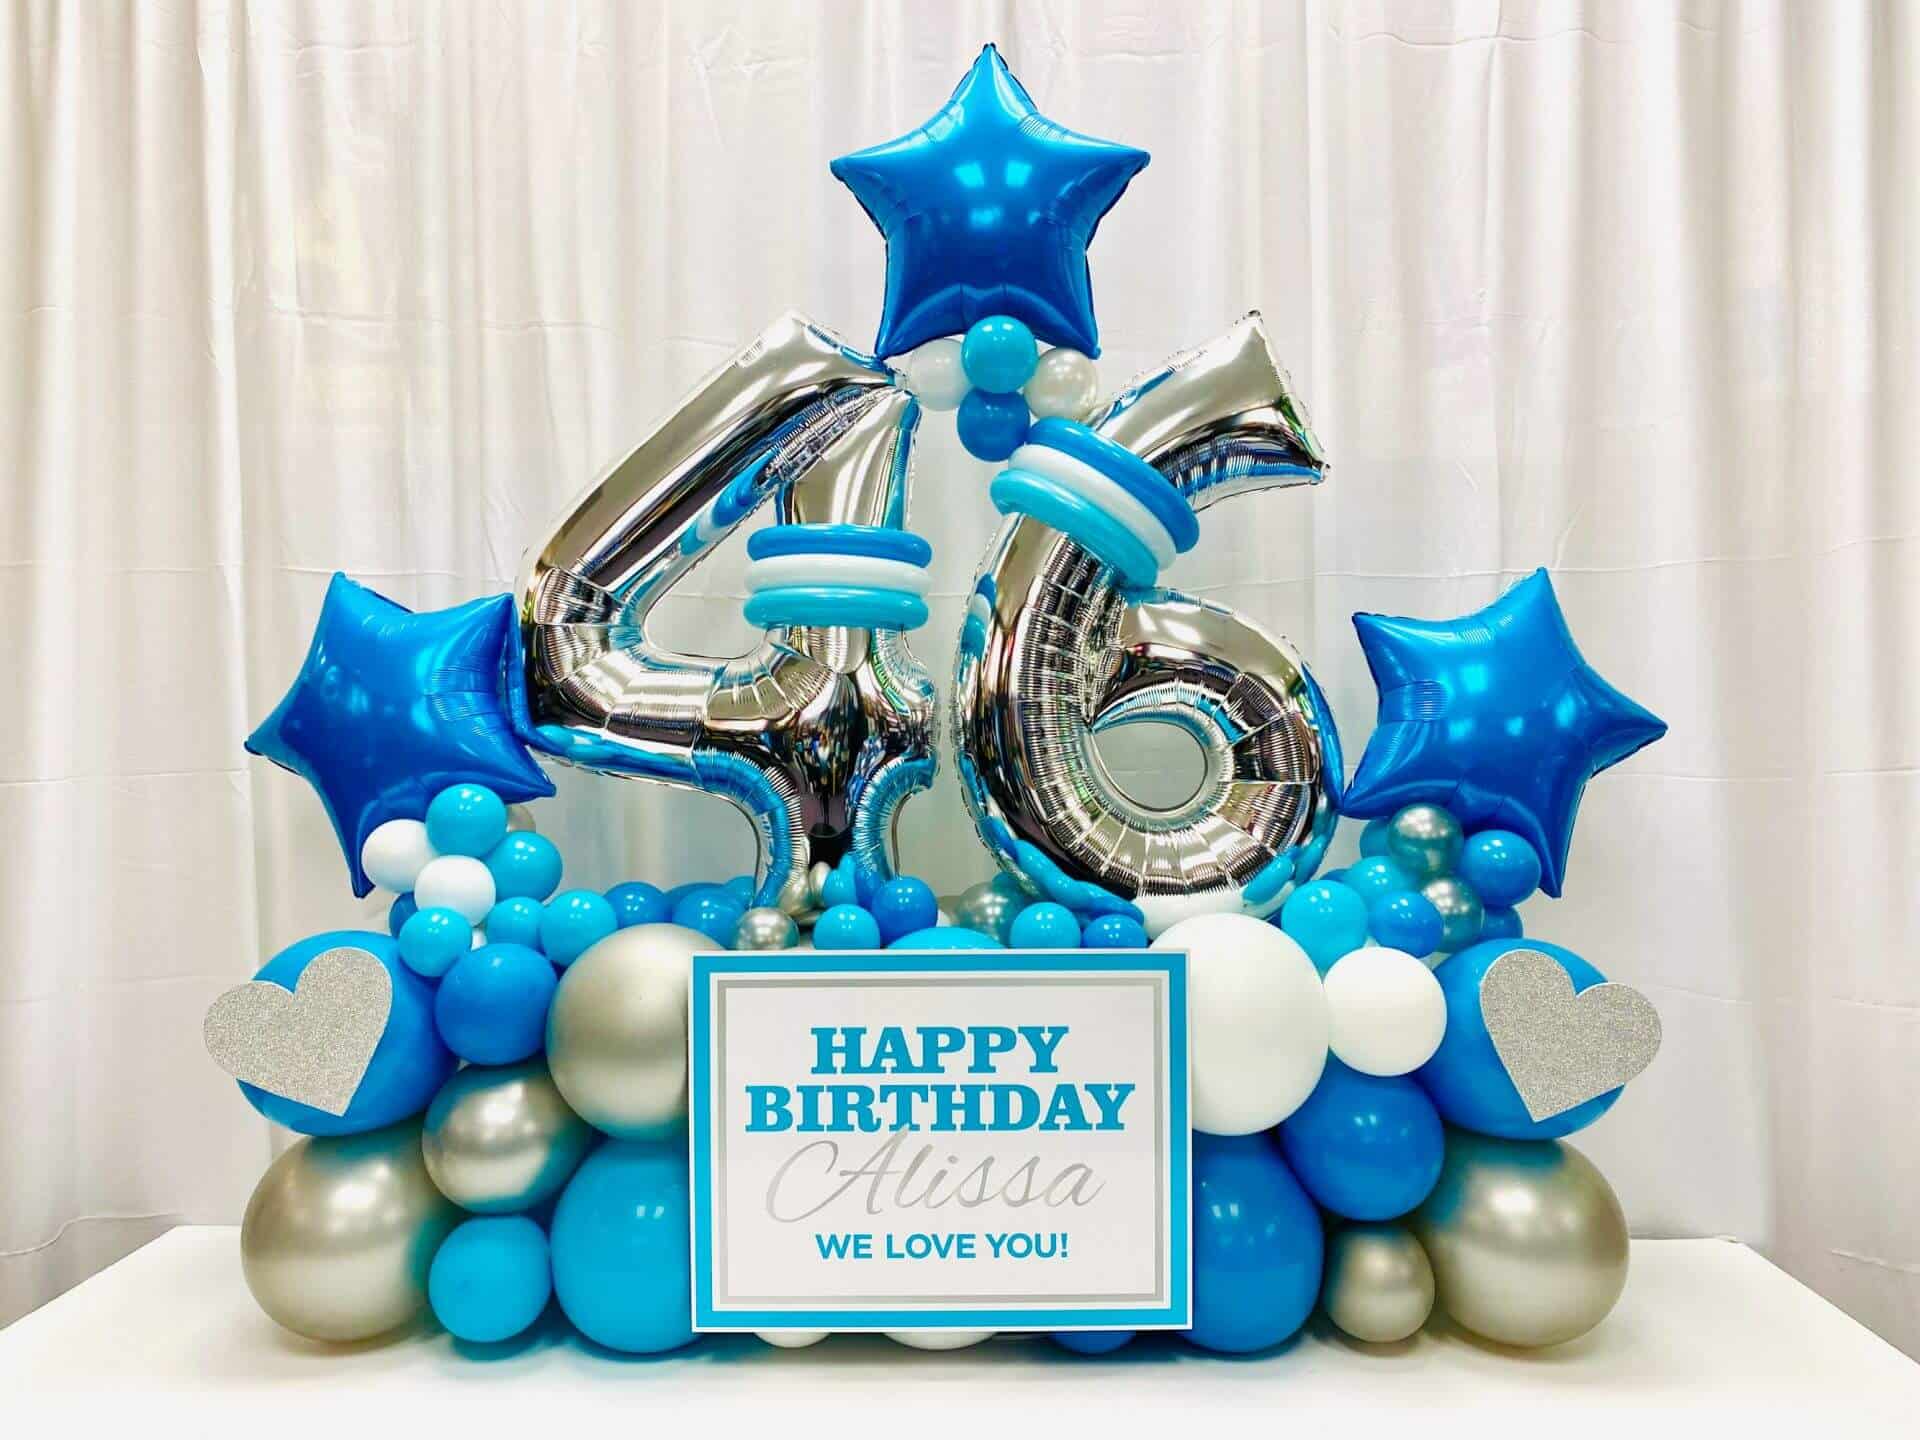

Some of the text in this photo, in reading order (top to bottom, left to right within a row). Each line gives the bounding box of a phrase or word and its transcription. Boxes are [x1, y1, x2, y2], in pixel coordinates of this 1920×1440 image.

[810, 1026, 1069, 1075] HAPPY
[745, 1082, 1136, 1133] BIRTHDAY
[766, 1124, 1106, 1223] Alissa
[815, 1232, 1068, 1260] WE LOVE YOU!
